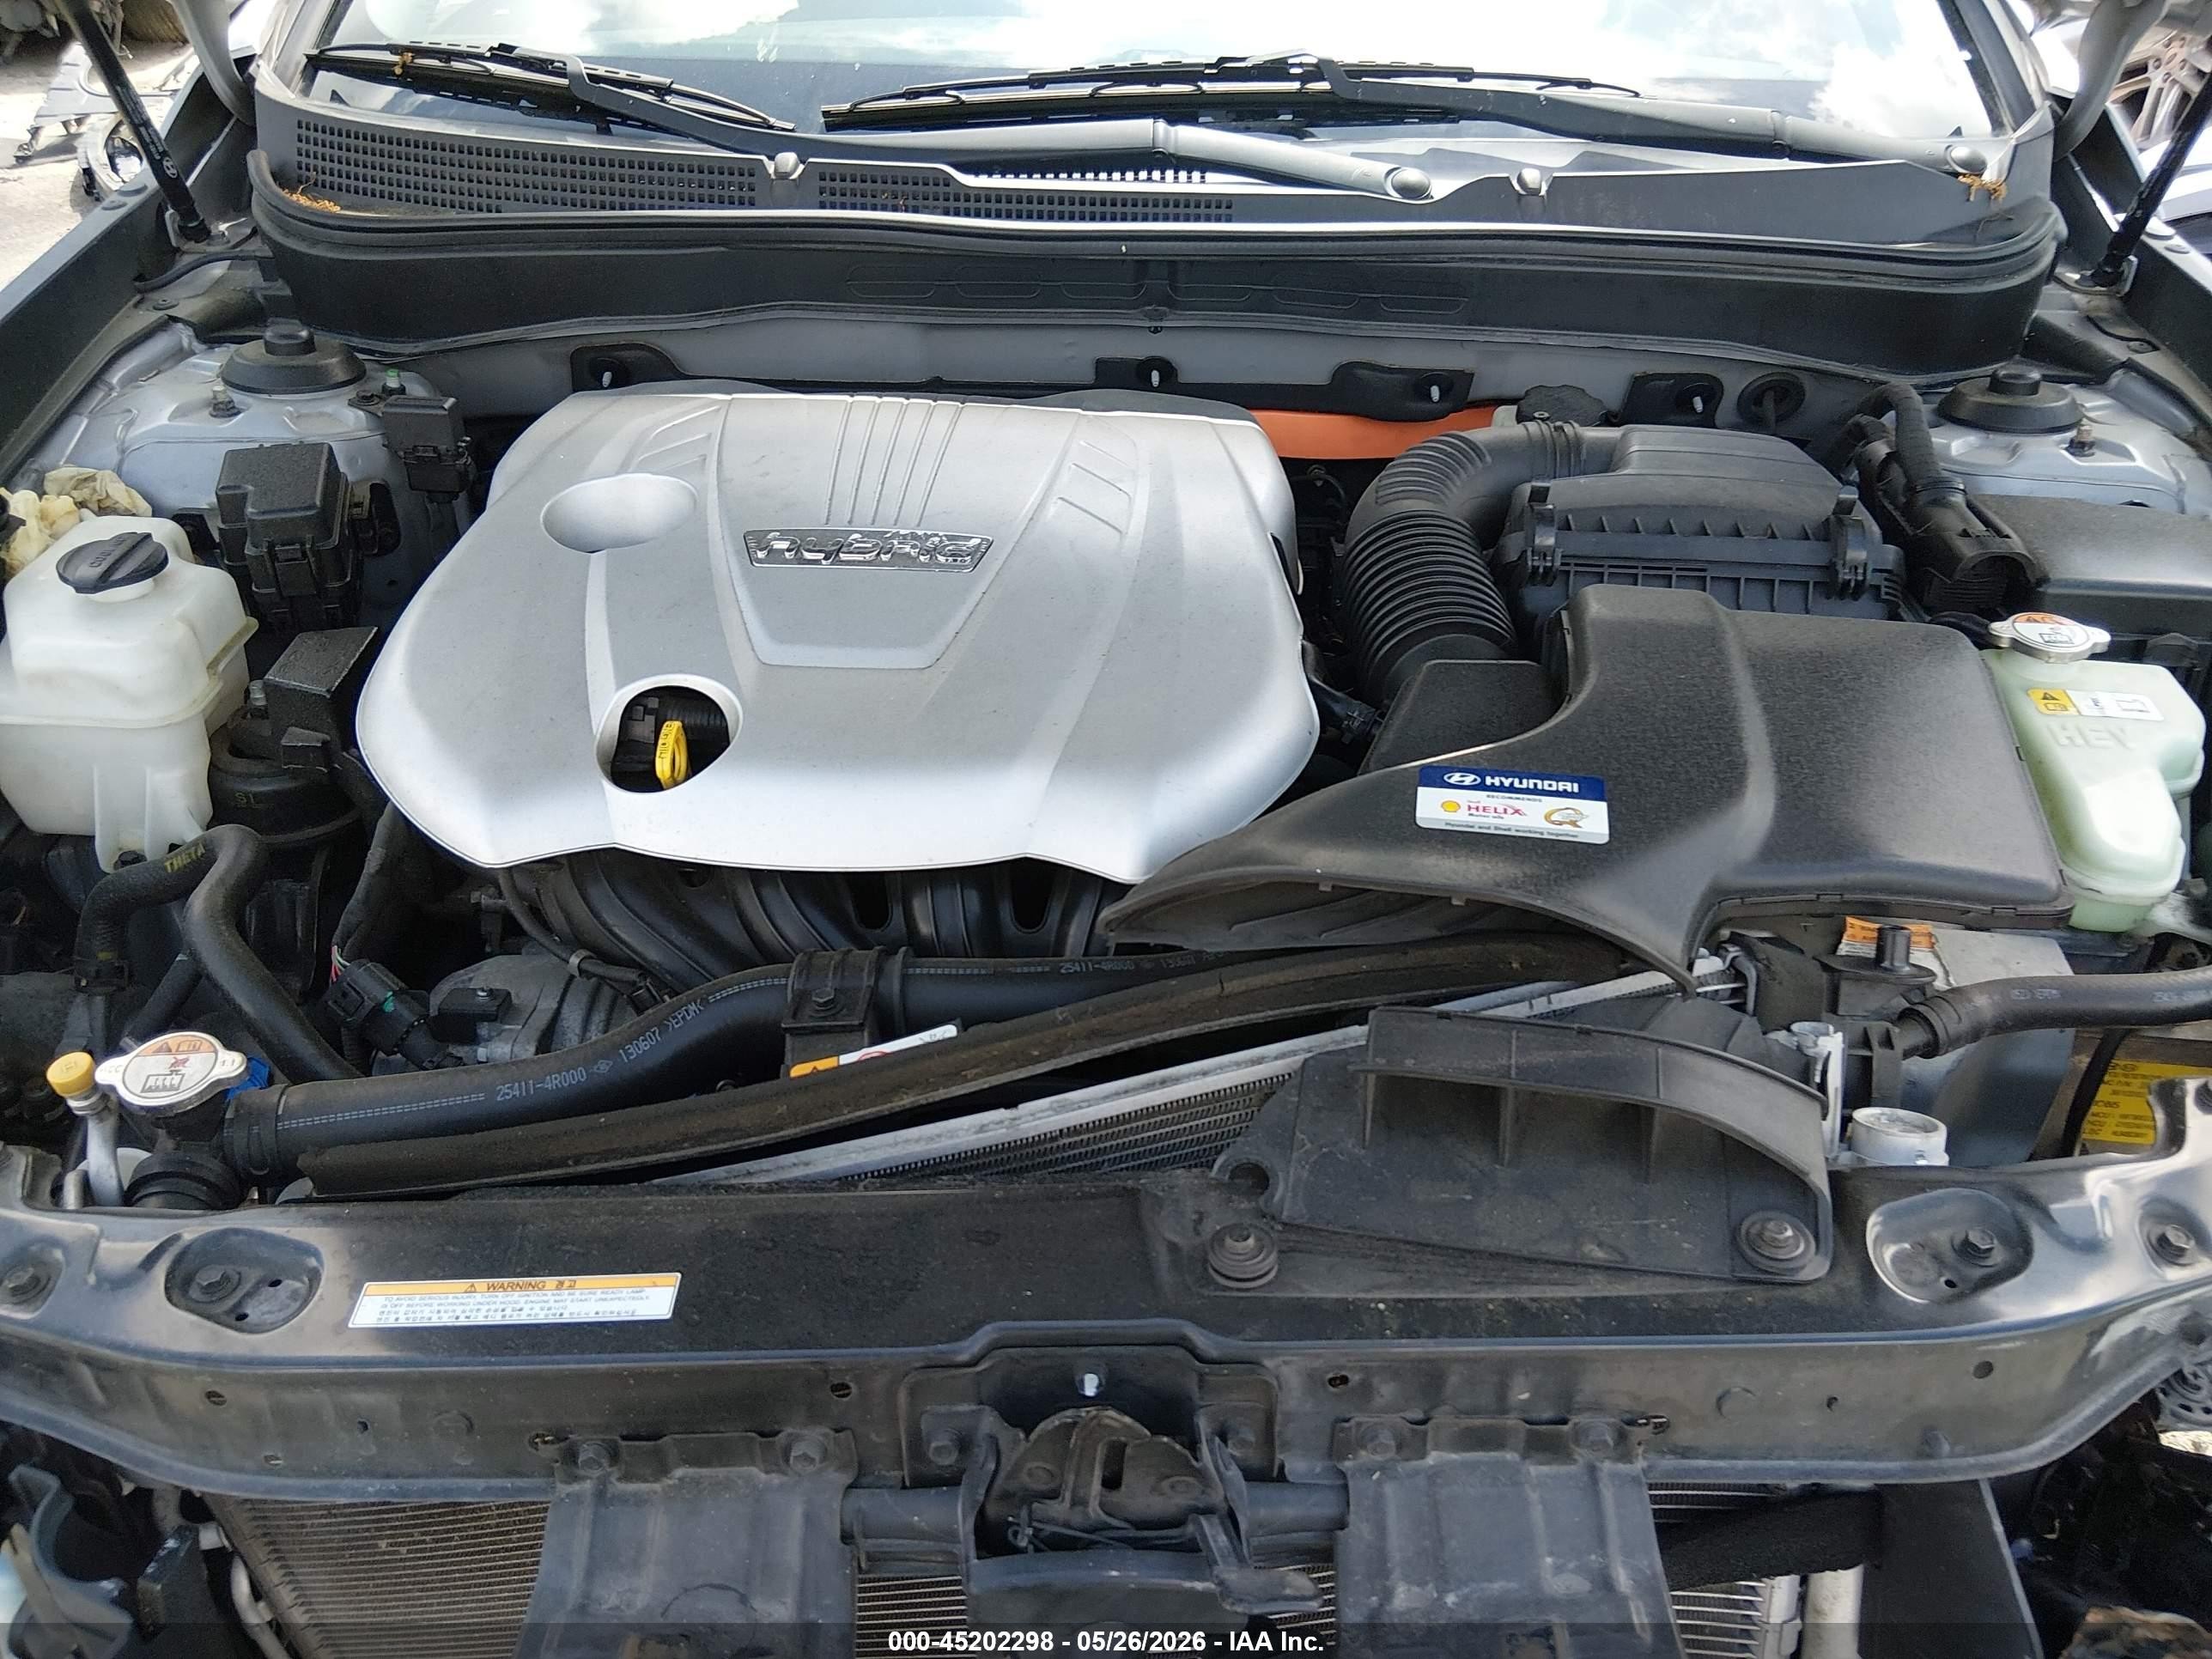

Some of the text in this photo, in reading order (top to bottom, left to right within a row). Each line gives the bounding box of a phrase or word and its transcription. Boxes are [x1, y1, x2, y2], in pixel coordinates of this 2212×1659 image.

[1485, 775, 1580, 793] HYUNDAI
[1467, 804, 1526, 816] HELIX
[495, 1066, 586, 1102] 25411-4R000
[618, 1027, 662, 1062] 130607
[487, 1280, 547, 1291] WARNING
